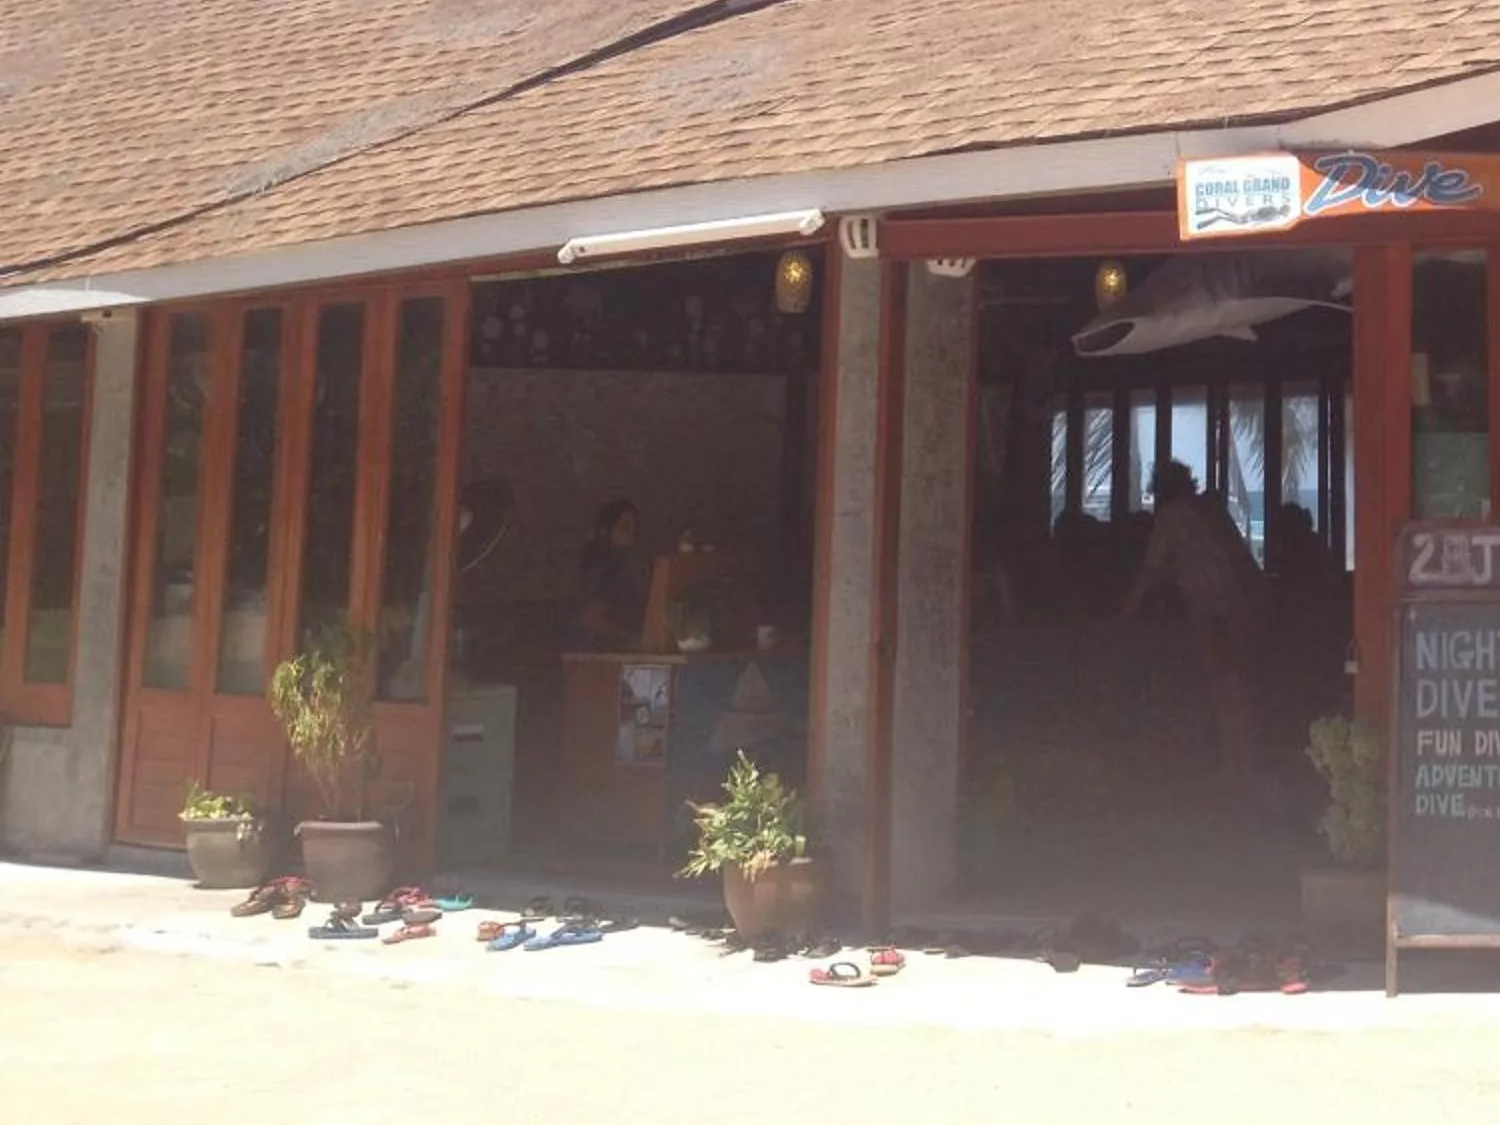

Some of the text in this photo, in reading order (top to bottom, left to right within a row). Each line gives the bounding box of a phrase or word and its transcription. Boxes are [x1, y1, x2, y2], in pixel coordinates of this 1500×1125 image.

[1195, 176, 1291, 197] CORAL GRAND
[1302, 151, 1483, 217] Dive
[1195, 194, 1292, 211] DIVERS
[1415, 678, 1499, 720] DIVE
[1416, 730, 1462, 757] FUN
[1415, 793, 1465, 818] DIVE
